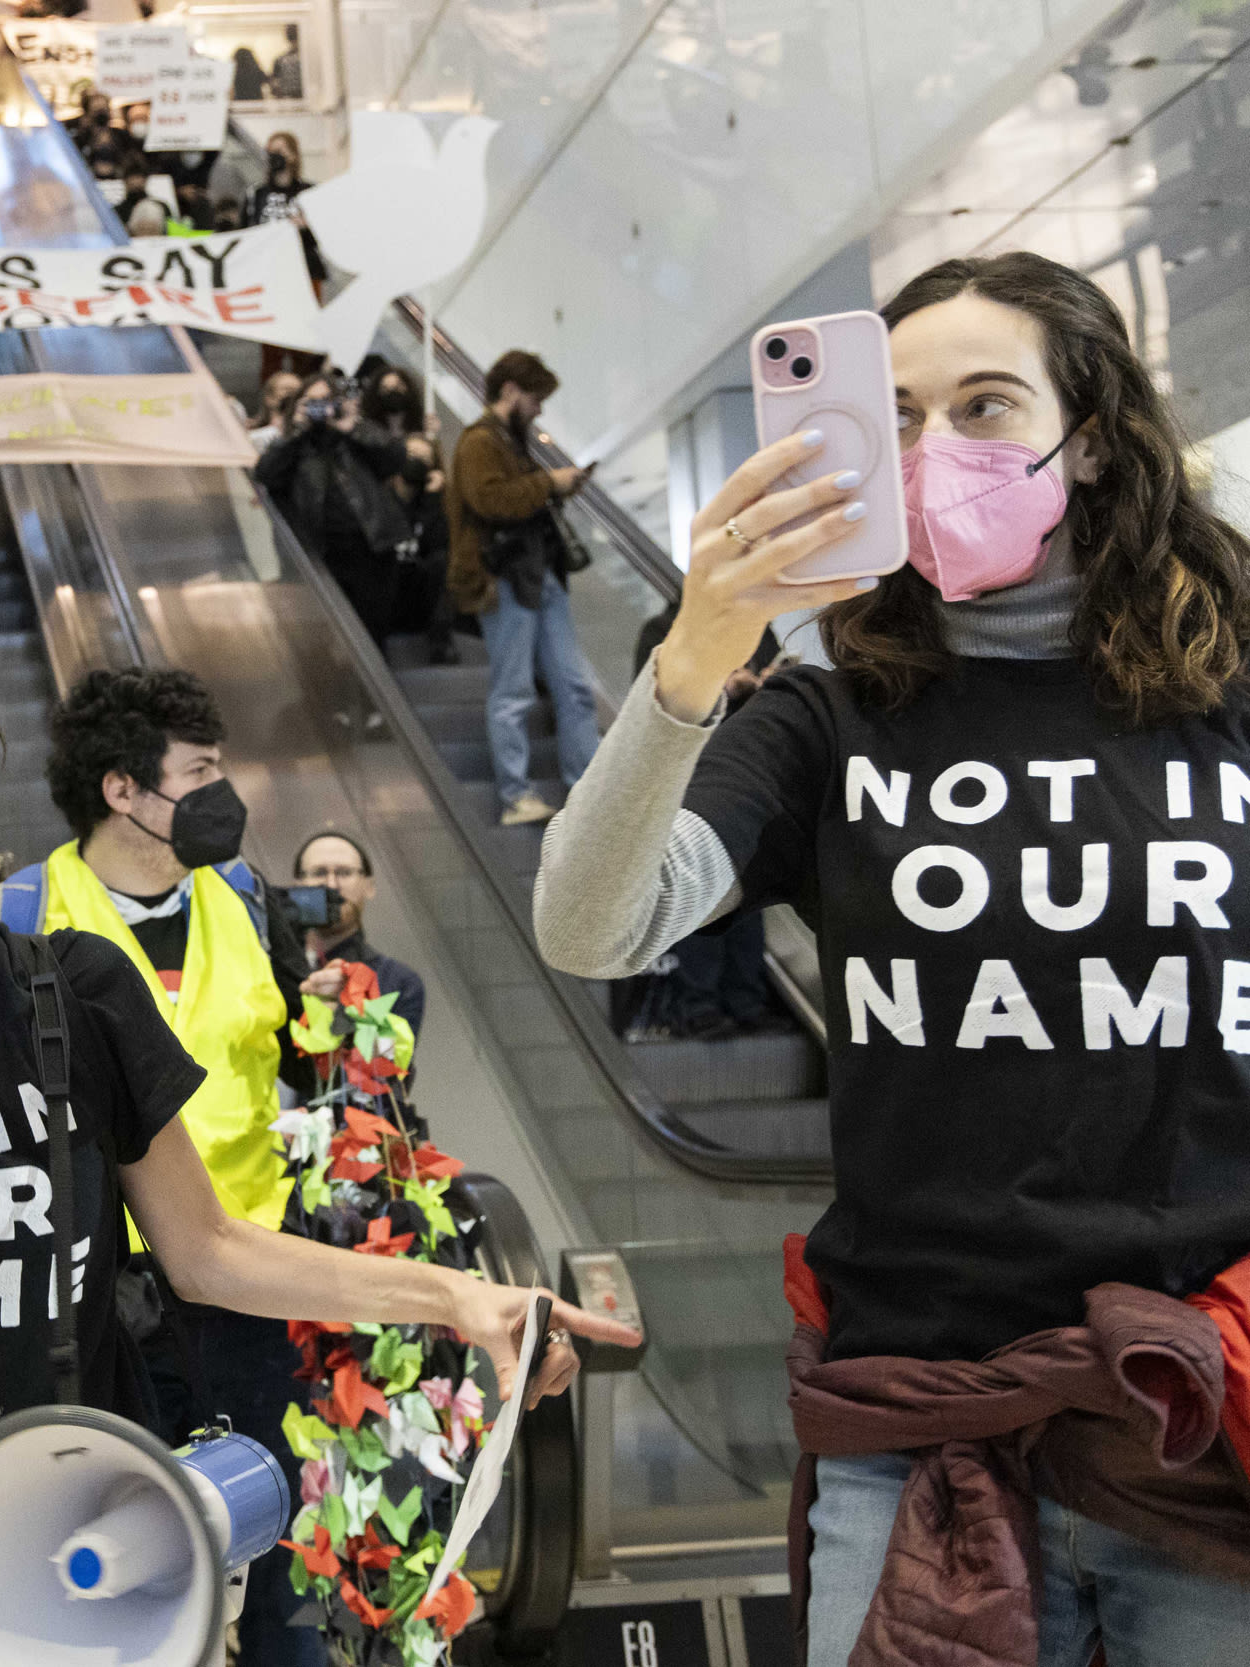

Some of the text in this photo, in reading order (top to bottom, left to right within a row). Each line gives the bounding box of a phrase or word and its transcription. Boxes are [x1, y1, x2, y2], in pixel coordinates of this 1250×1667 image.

[102, 238, 241, 292] SAY
[846, 756, 1097, 827] NOT
[892, 842, 1233, 932] OUR
[845, 956, 1250, 1055] NAME
